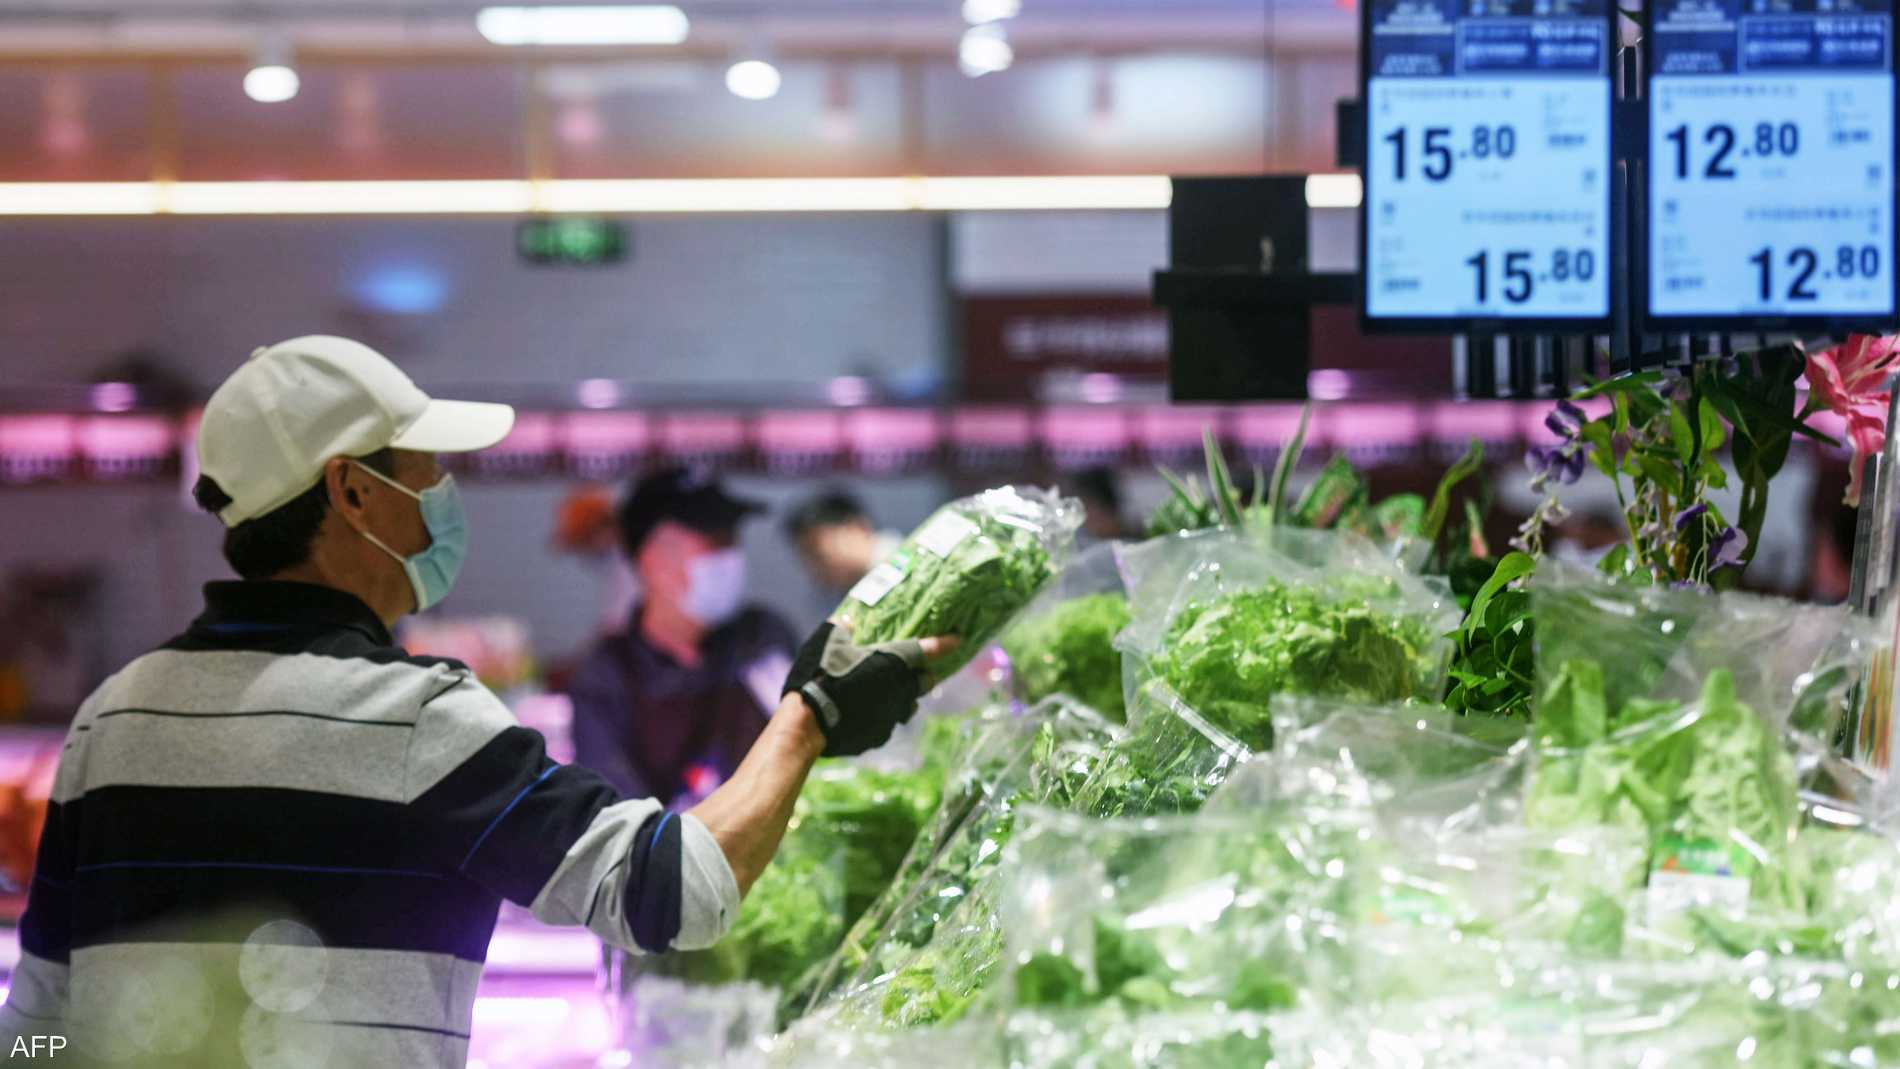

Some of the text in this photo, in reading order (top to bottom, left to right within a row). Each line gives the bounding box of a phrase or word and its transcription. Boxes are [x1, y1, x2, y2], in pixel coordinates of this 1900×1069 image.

[1384, 125, 1516, 181] 15.80
[1666, 122, 1800, 180] 12.80
[1465, 249, 1595, 305] 15.80
[1749, 244, 1880, 303] 12.80
